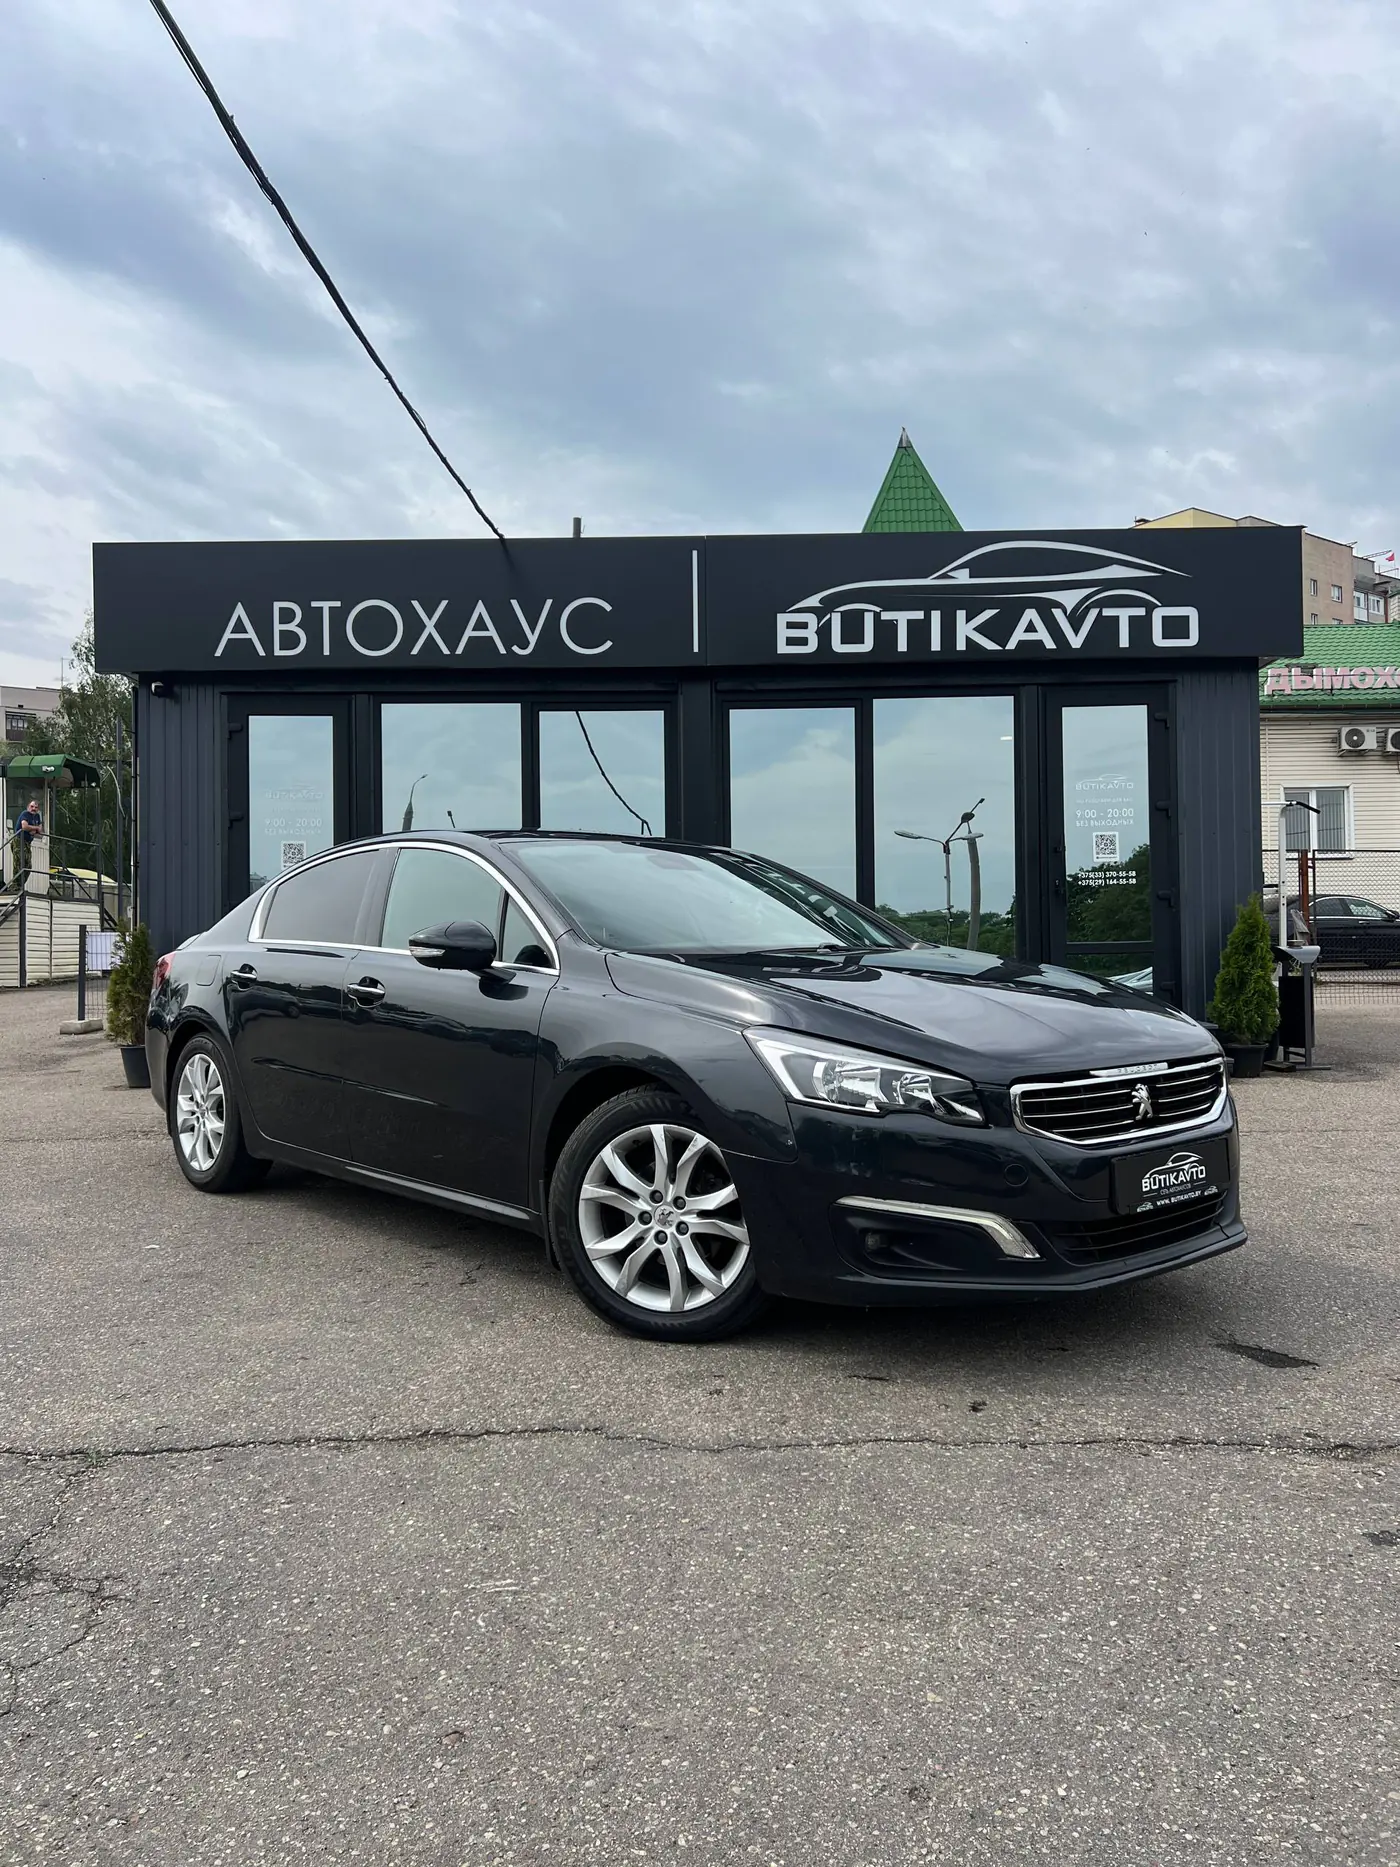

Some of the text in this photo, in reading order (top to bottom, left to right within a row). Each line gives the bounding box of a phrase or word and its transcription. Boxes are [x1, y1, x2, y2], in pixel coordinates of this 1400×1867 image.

[214, 597, 613, 657] АВТОХАУС
[776, 605, 1199, 654] BUTIKAVTO
[1075, 809, 1097, 819] 9:00
[1107, 808, 1134, 818] 20:00
[1090, 819, 1134, 827] ВЫХОДНЫХ
[1141, 1166, 1206, 1192] BUTIKAVTO
